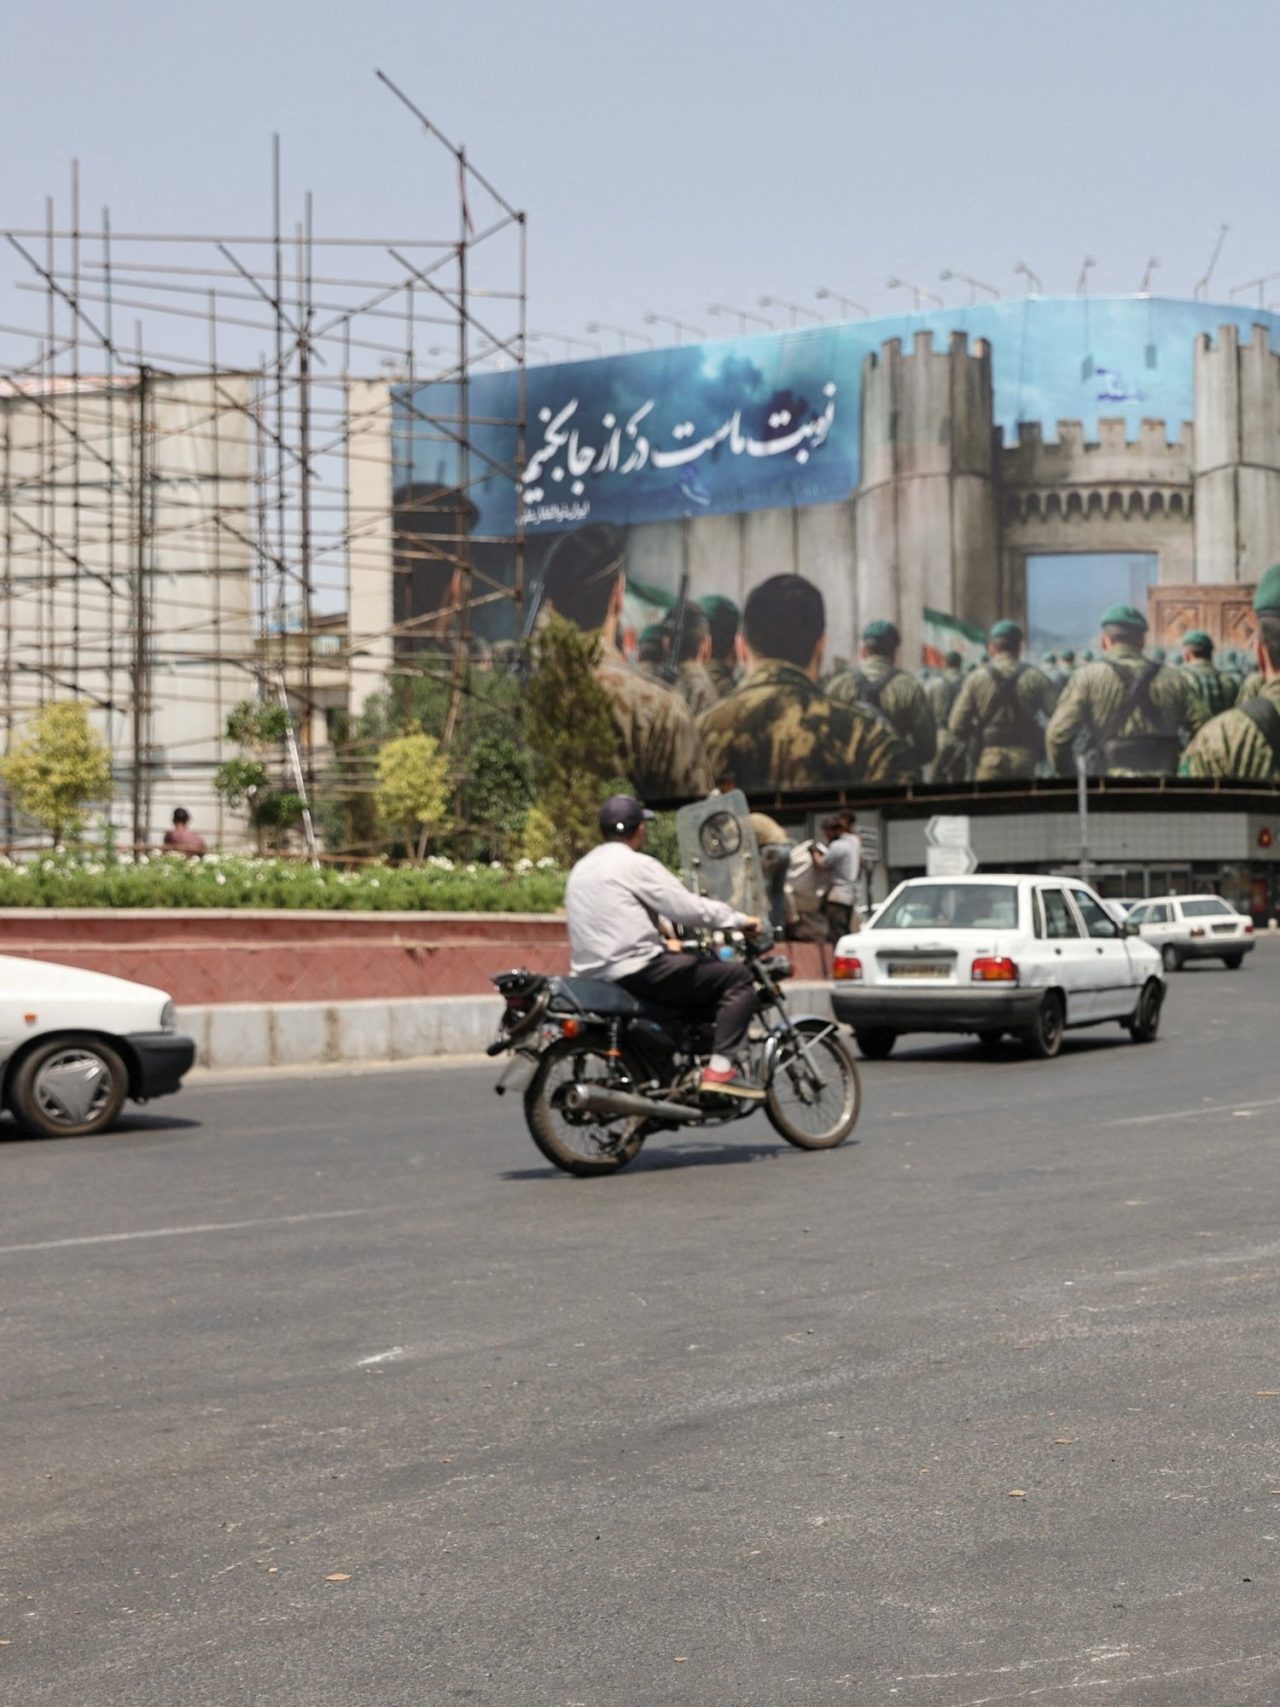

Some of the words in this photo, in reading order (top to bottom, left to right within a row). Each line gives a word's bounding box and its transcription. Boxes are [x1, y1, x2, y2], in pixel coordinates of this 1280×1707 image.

[591, 412, 622, 473] از
[651, 408, 745, 468] ماست
[747, 381, 837, 464] نوبت
[565, 426, 597, 496] جا
